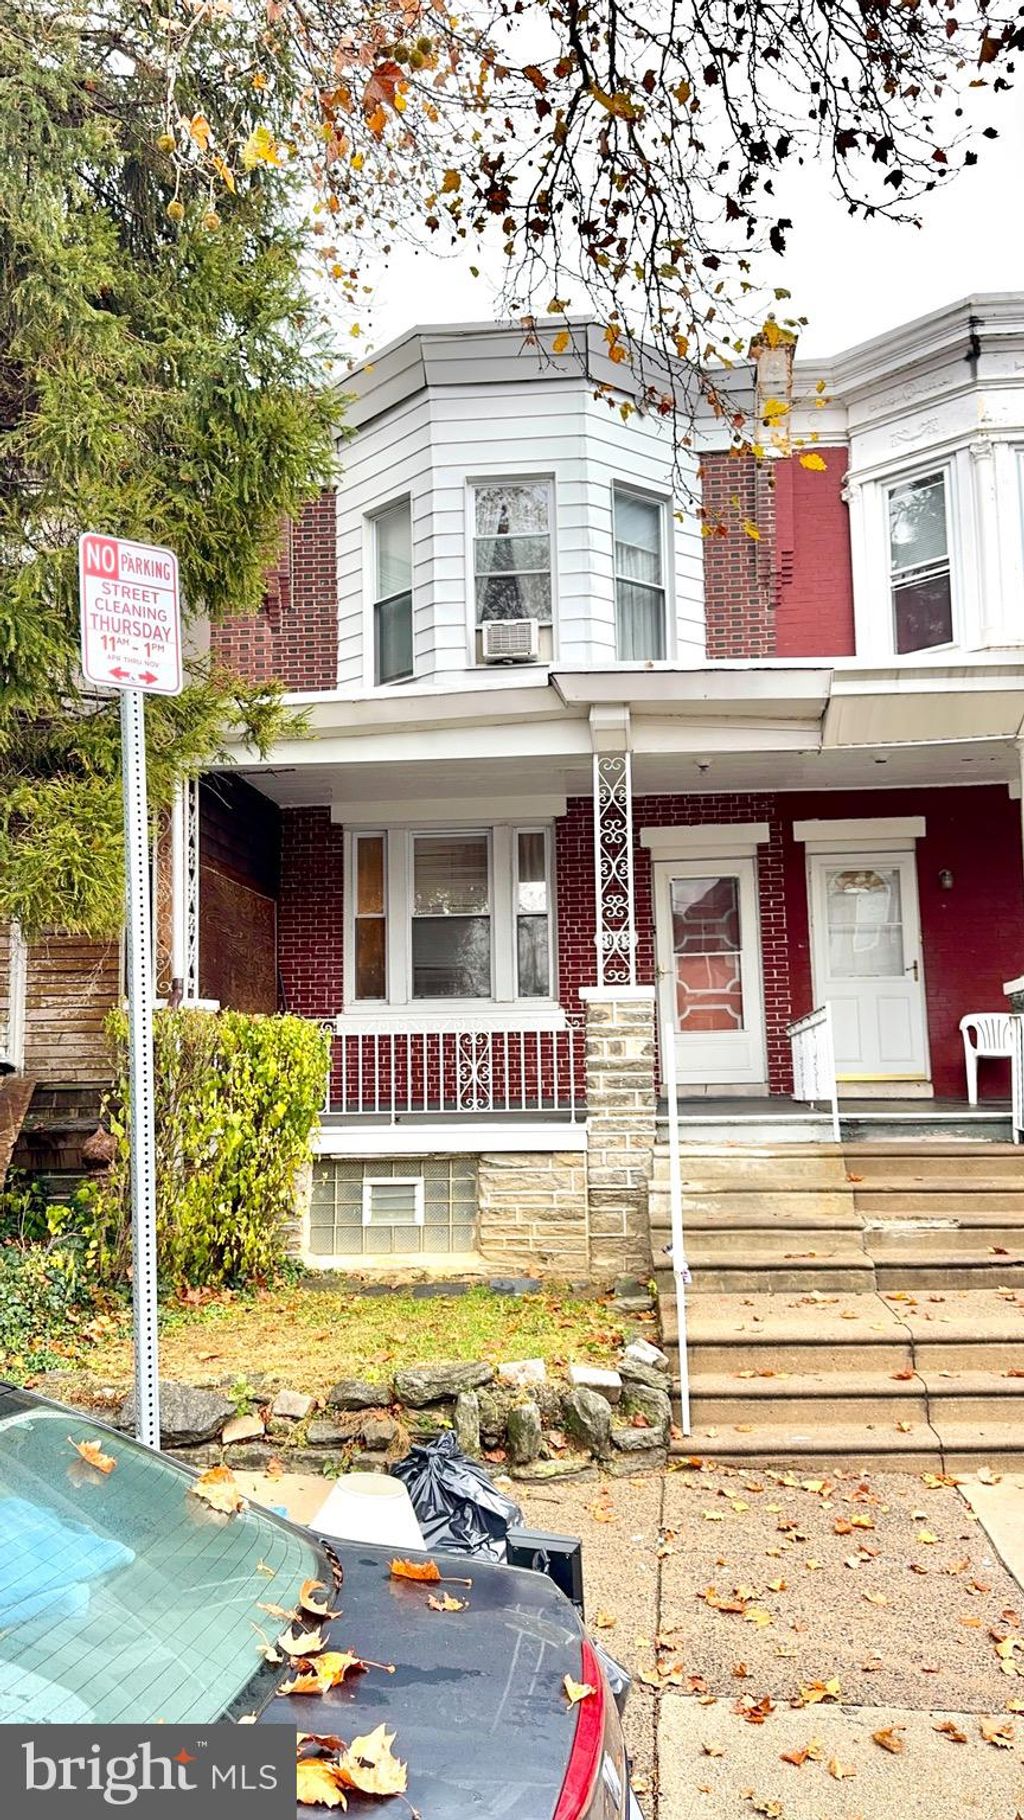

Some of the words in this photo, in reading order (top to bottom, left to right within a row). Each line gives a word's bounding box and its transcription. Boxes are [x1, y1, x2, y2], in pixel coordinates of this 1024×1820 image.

[86, 542, 115, 573] NO
[121, 553, 171, 581] PARKING
[101, 581, 160, 605] STREET
[94, 597, 167, 622] CLEANING
[90, 612, 171, 643] THURSDAY
[107, 653, 121, 662] APR
[123, 656, 142, 666] THRU
[144, 660, 160, 669] NOV
